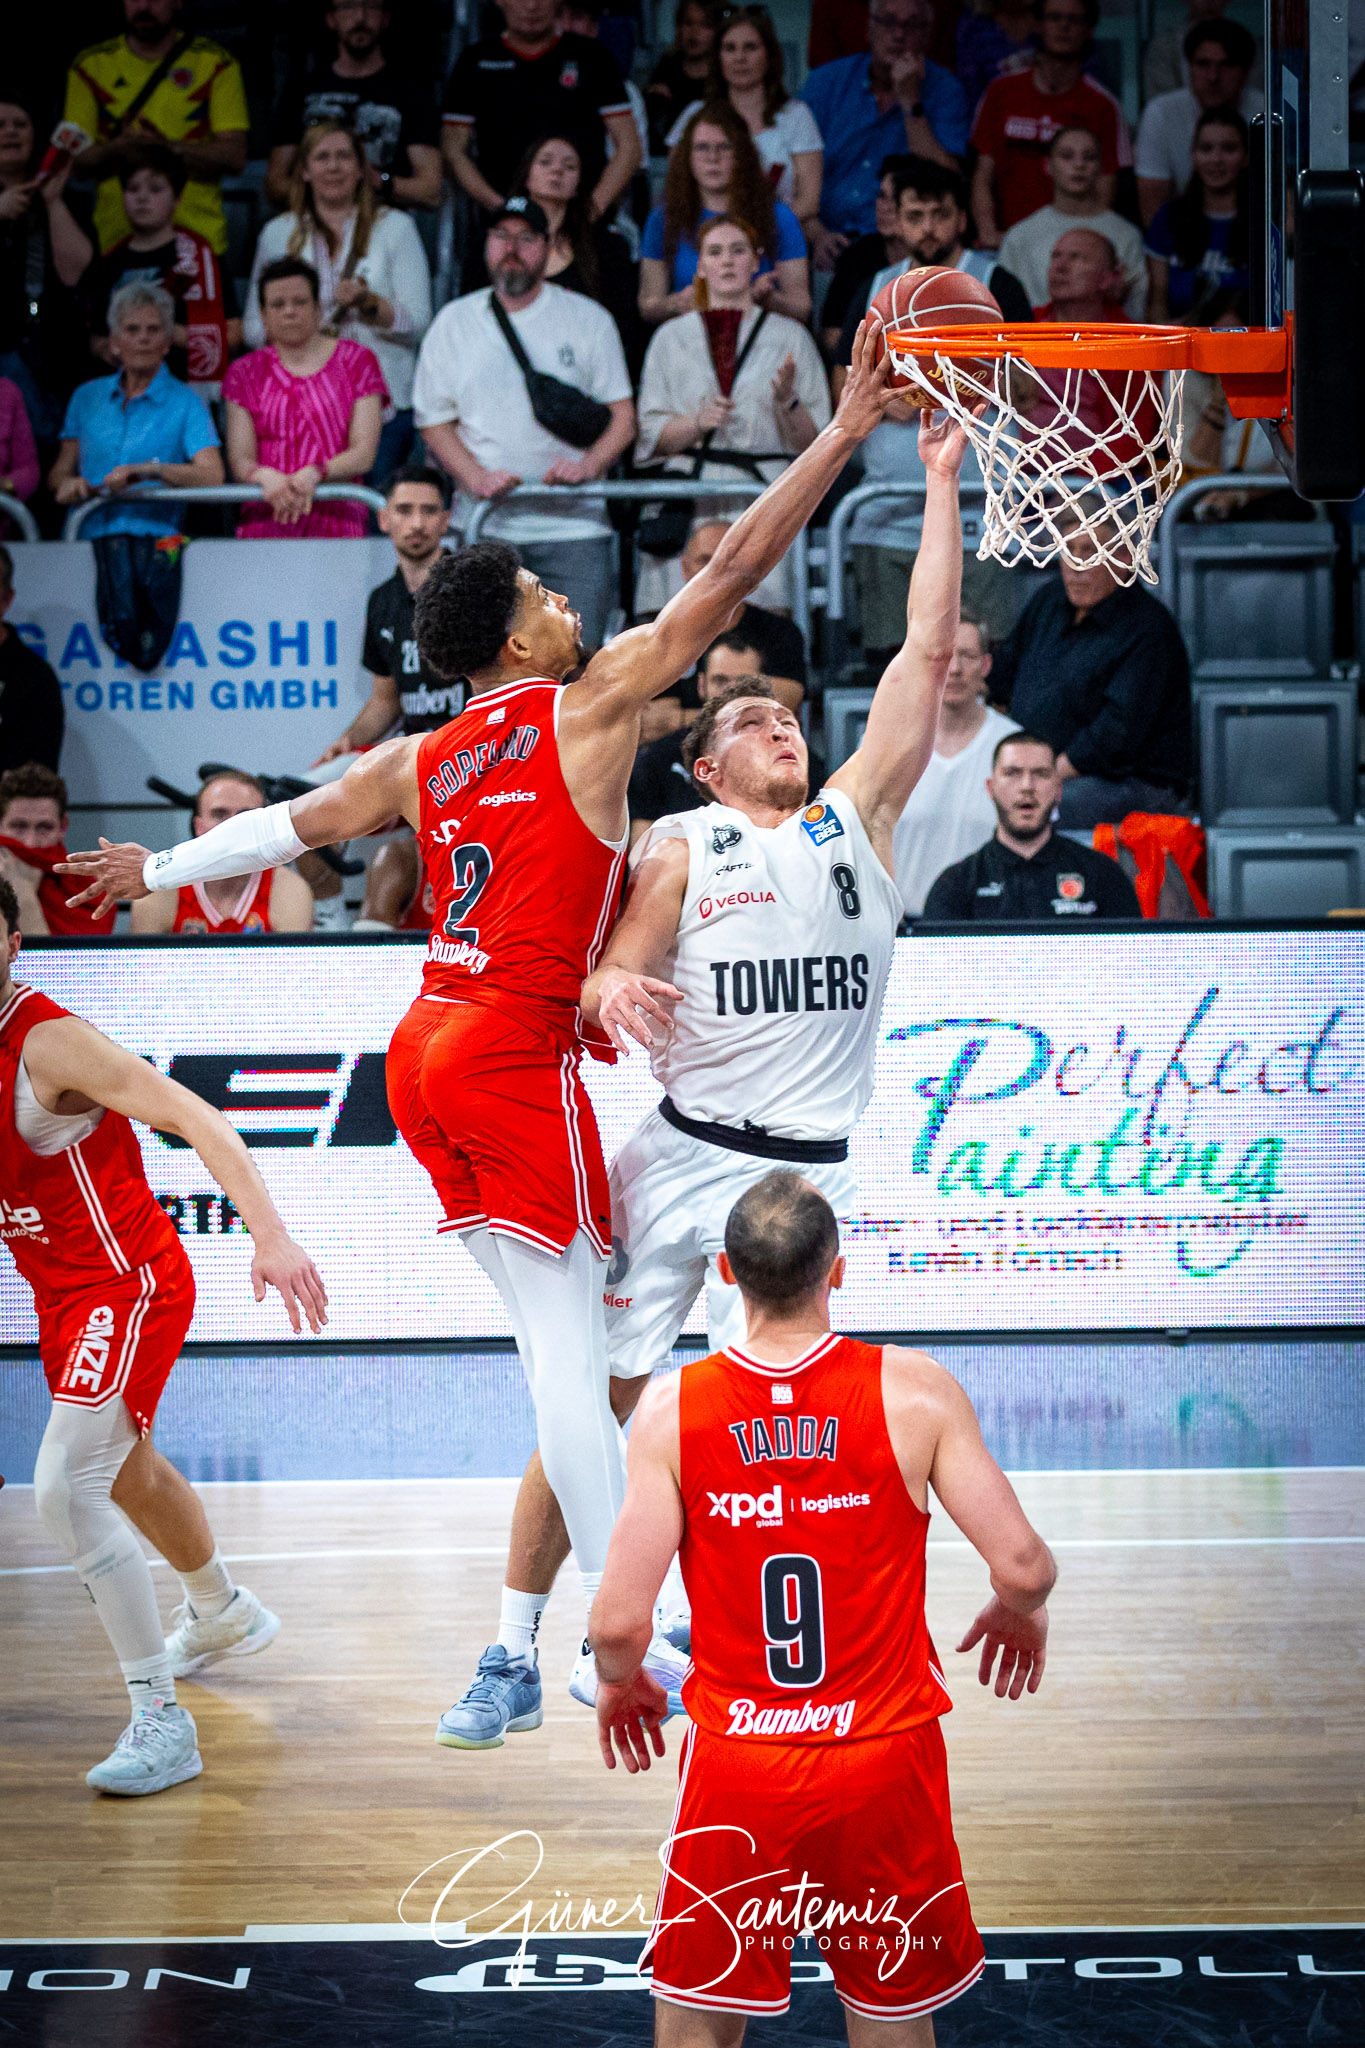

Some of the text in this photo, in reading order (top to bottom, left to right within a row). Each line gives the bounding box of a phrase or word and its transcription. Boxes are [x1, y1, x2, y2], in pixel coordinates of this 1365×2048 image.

[14, 619, 338, 669] GAASHI
[60, 678, 338, 710] OREN GMBH
[815, 824, 842, 844] BBL
[444, 842, 493, 946] 2
[716, 891, 777, 909] VEOLIA
[831, 862, 862, 920] 8
[710, 953, 869, 1016] TOWERS
[728, 1416, 839, 1466] TADDA
[706, 1485, 871, 1527] xpd logistics
[756, 1518, 783, 1528] global
[760, 1553, 826, 1689] 9
[725, 1698, 856, 1737] Bamberg
